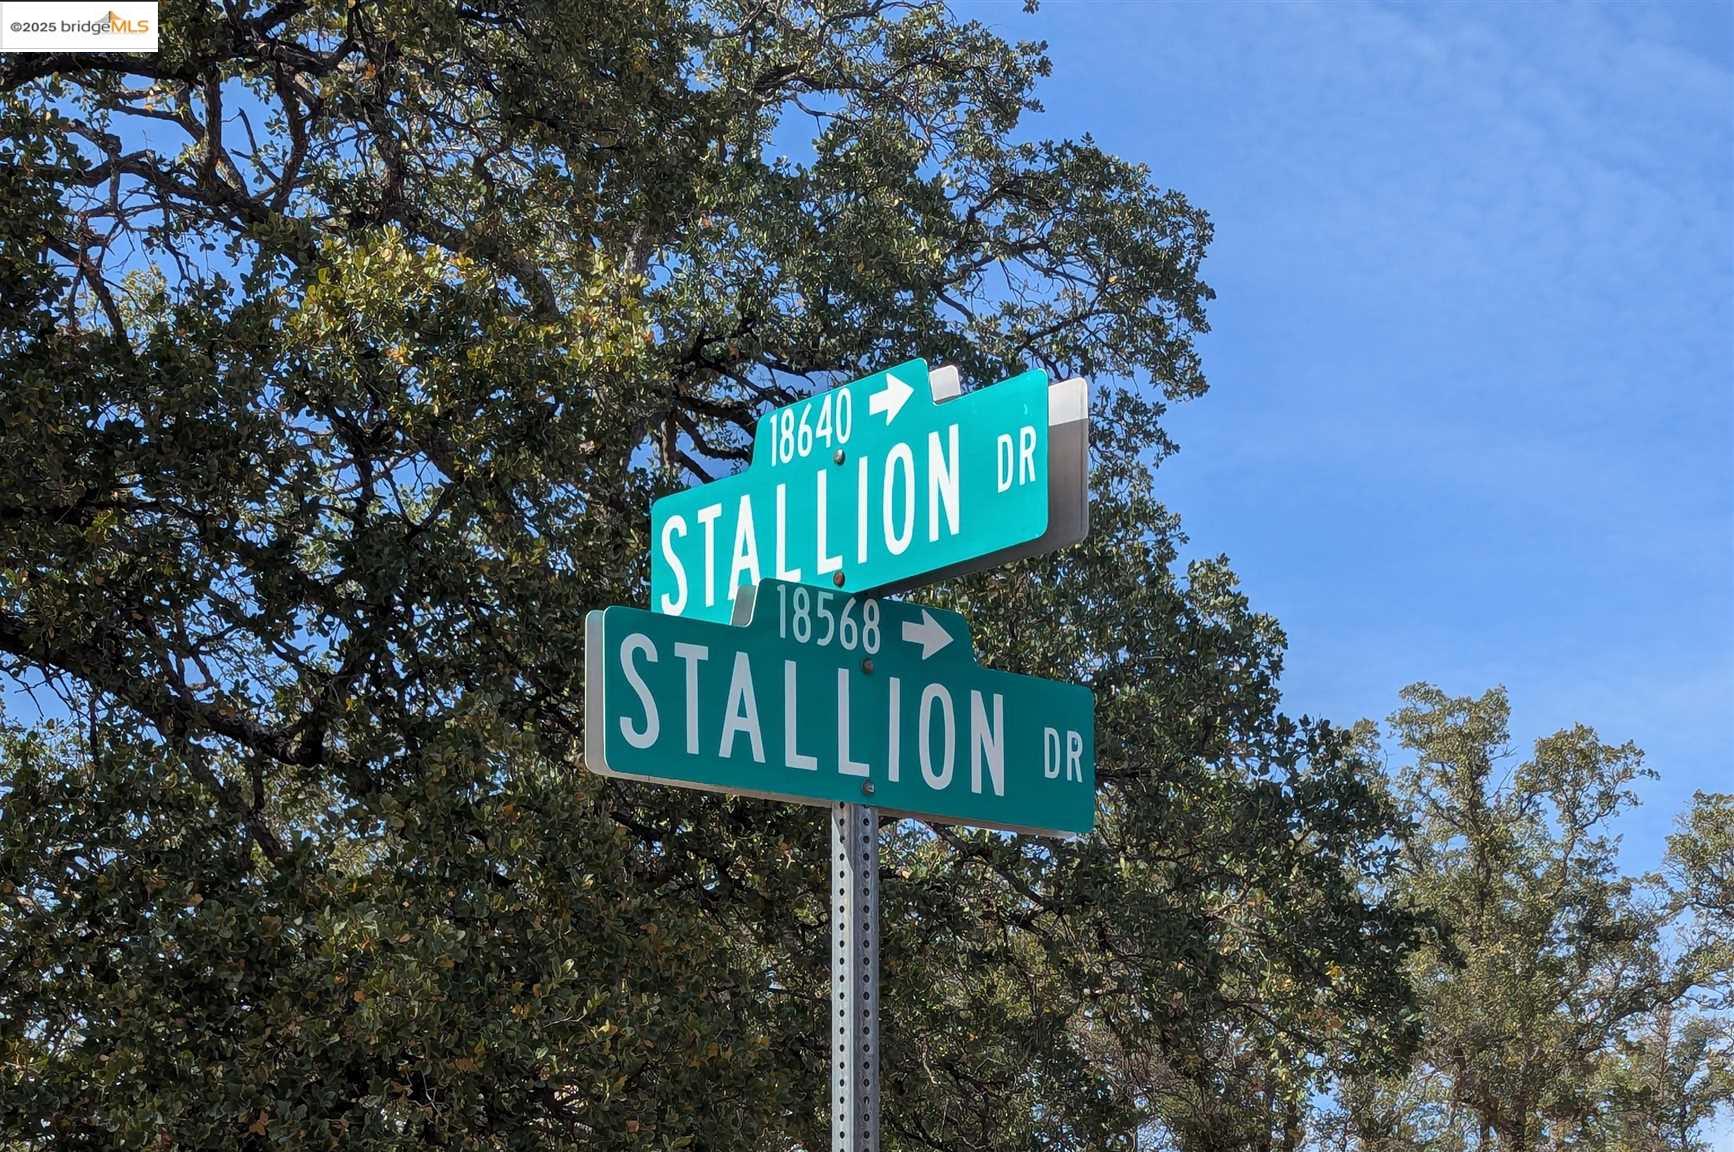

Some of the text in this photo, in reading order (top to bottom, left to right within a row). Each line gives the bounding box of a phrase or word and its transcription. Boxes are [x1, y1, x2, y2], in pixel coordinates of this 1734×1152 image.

[770, 387, 852, 467] 18640
[661, 424, 1037, 616] STALLION DR
[777, 584, 881, 655] 18568
[619, 633, 1083, 797] STALLION DR
